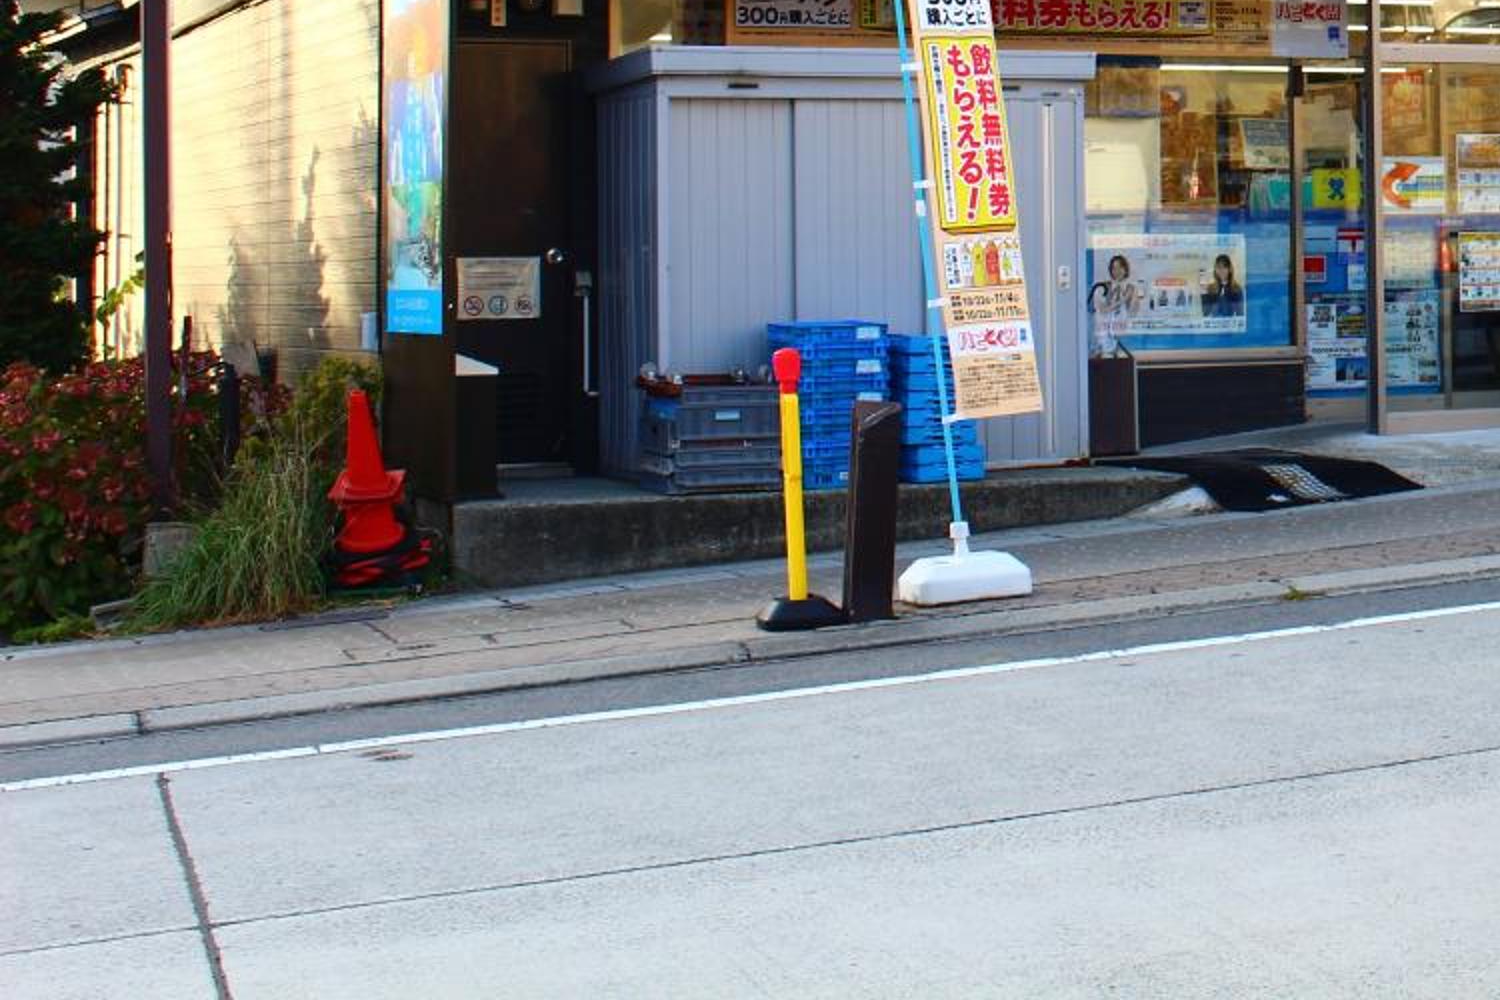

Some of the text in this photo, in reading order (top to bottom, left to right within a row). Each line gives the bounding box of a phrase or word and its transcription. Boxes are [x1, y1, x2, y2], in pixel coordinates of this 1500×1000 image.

[946, 44, 983, 220] もらえる!
[969, 43, 1010, 217] 飲料無料券
